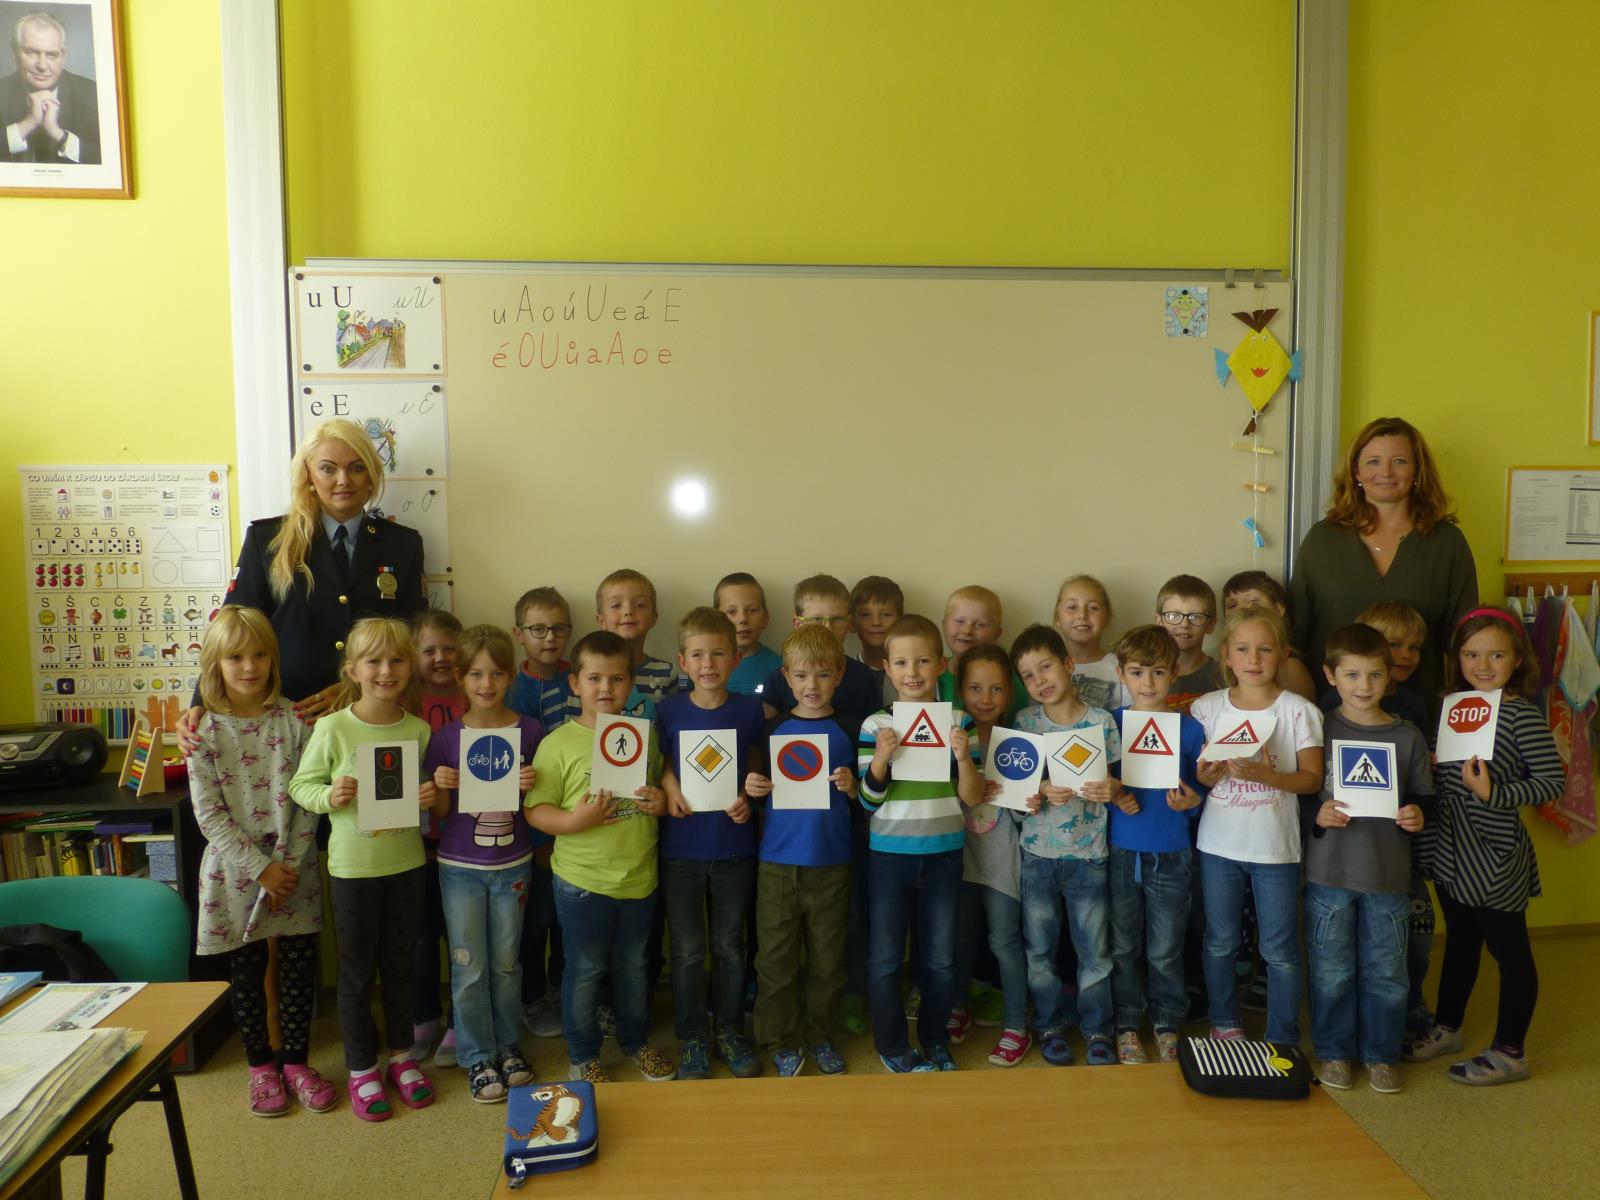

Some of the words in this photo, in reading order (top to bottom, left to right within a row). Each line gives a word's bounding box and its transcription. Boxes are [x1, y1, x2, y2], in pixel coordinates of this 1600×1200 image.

[306, 291, 323, 308] u
[331, 285, 353, 309] U
[310, 400, 324, 417] e
[332, 394, 350, 416] E
[35, 528, 41, 537] 1
[54, 527, 62, 537] 2
[73, 527, 80, 537] 3
[91, 527, 98, 537] 4
[110, 527, 118, 537] 5
[128, 527, 136, 537] 6
[41, 597, 50, 608] S
[66, 595, 75, 607] Š
[90, 596, 100, 607] C
[114, 595, 124, 607] Č
[140, 596, 148, 606] Z
[163, 594, 172, 606] Ž
[187, 595, 197, 605] R
[42, 633, 53, 644] M
[68, 634, 77, 644] N
[93, 633, 102, 643] P
[117, 633, 127, 643] B
[142, 633, 149, 643] L
[166, 632, 175, 642] K
[189, 632, 198, 641] H
[1450, 706, 1489, 723] STOP
